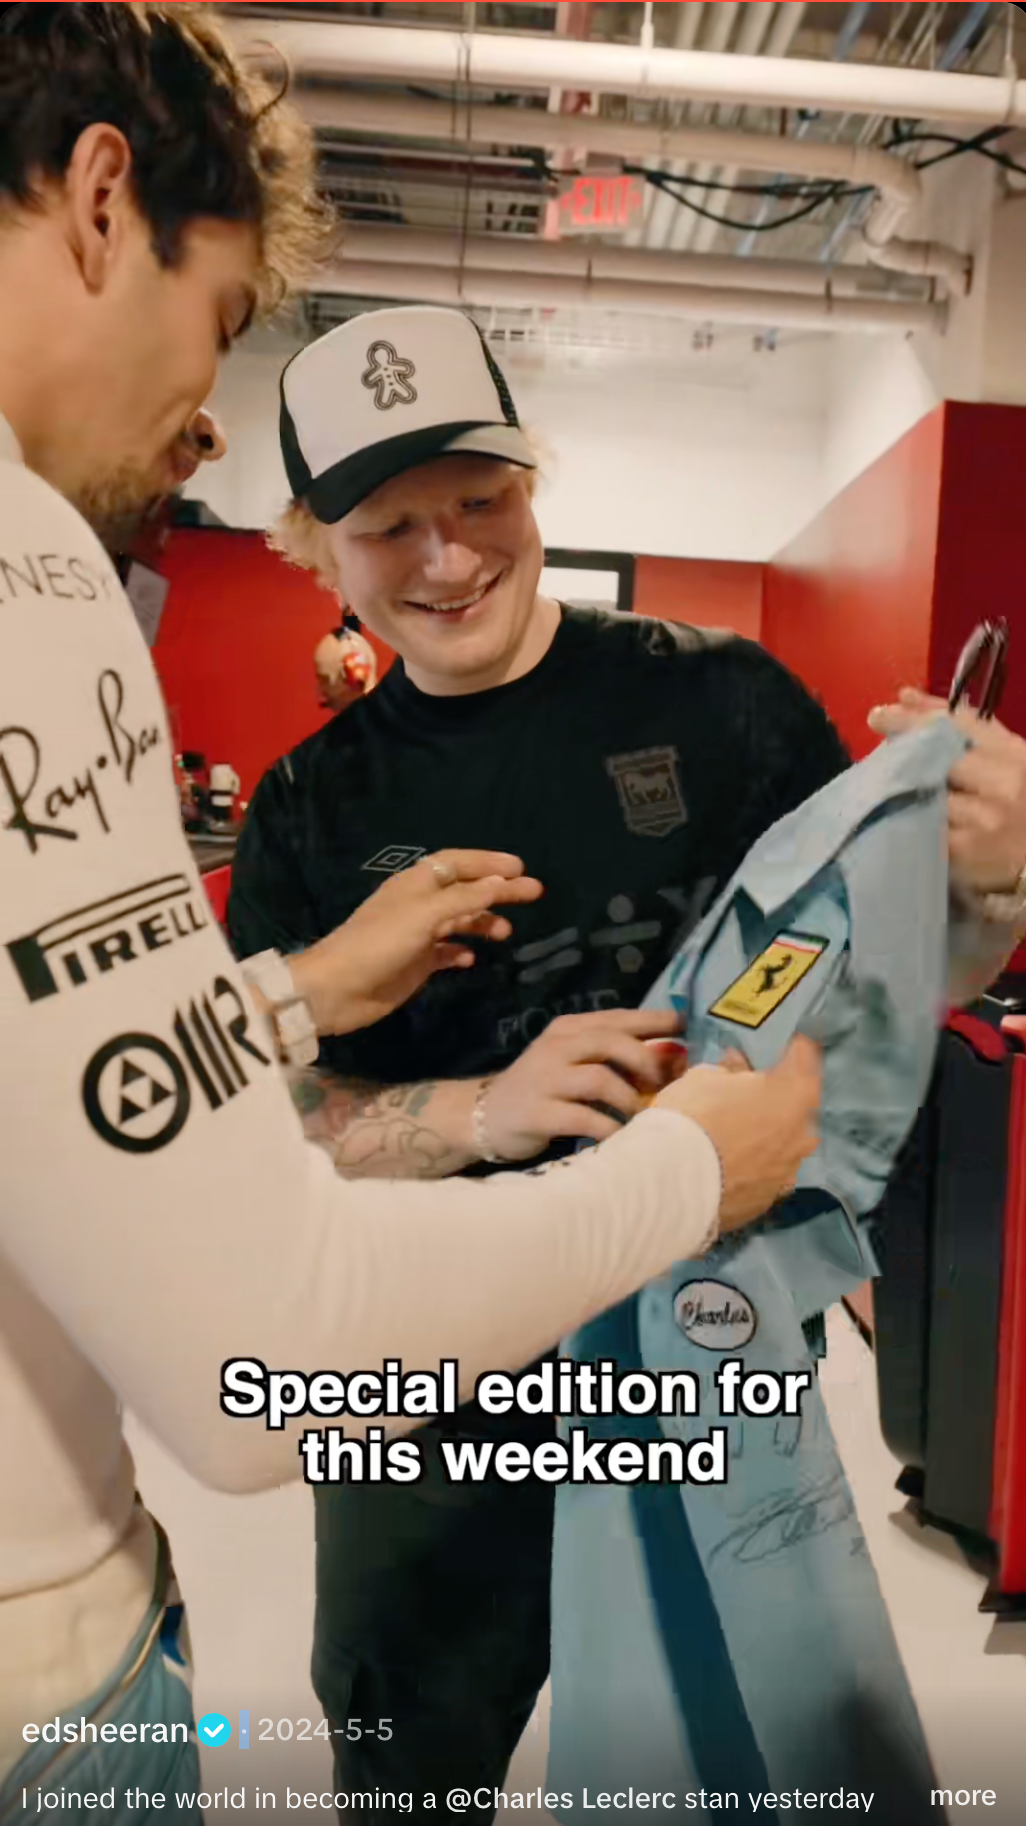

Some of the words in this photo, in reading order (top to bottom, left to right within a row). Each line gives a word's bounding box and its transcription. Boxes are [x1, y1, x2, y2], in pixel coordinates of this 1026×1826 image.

[572, 176, 633, 226] EXIT
[0, 554, 112, 603] NES
[4, 873, 209, 1004] PIRELL
